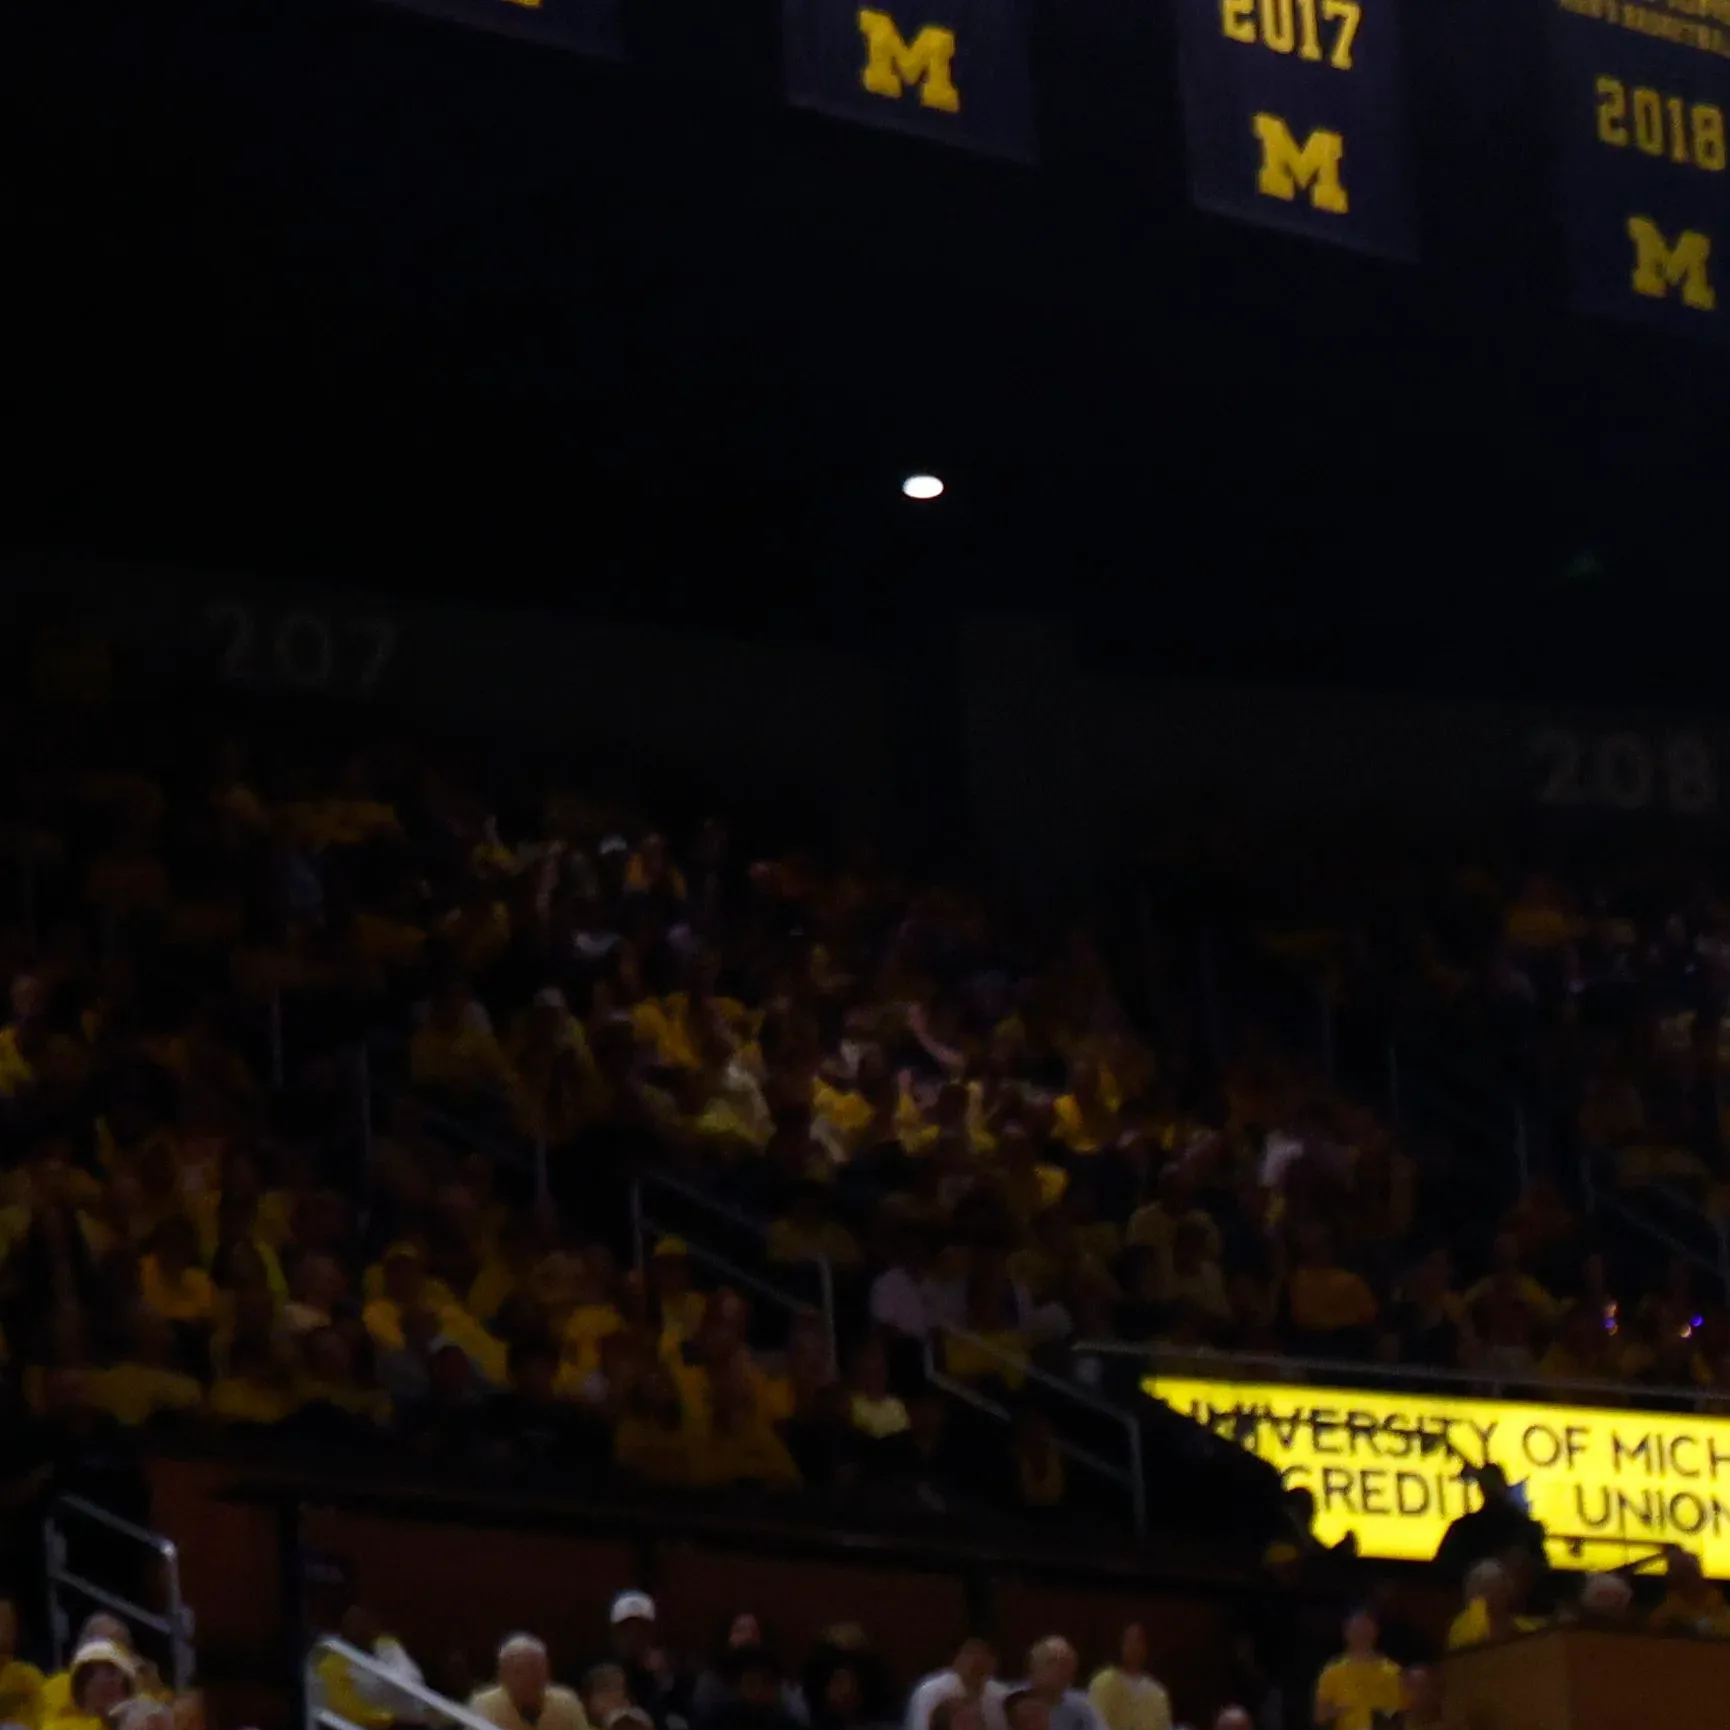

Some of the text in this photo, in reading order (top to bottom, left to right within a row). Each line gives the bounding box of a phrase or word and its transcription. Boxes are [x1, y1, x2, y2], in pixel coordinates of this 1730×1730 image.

[856, 6, 961, 112] M
[1220, 0, 1363, 72] 2017
[1250, 112, 1349, 214] M
[1594, 73, 1728, 172] 2018
[1625, 212, 1718, 312] M
[202, 597, 400, 700] 207
[1524, 726, 1720, 816] 208
[1521, 1423, 1592, 1470] OF
